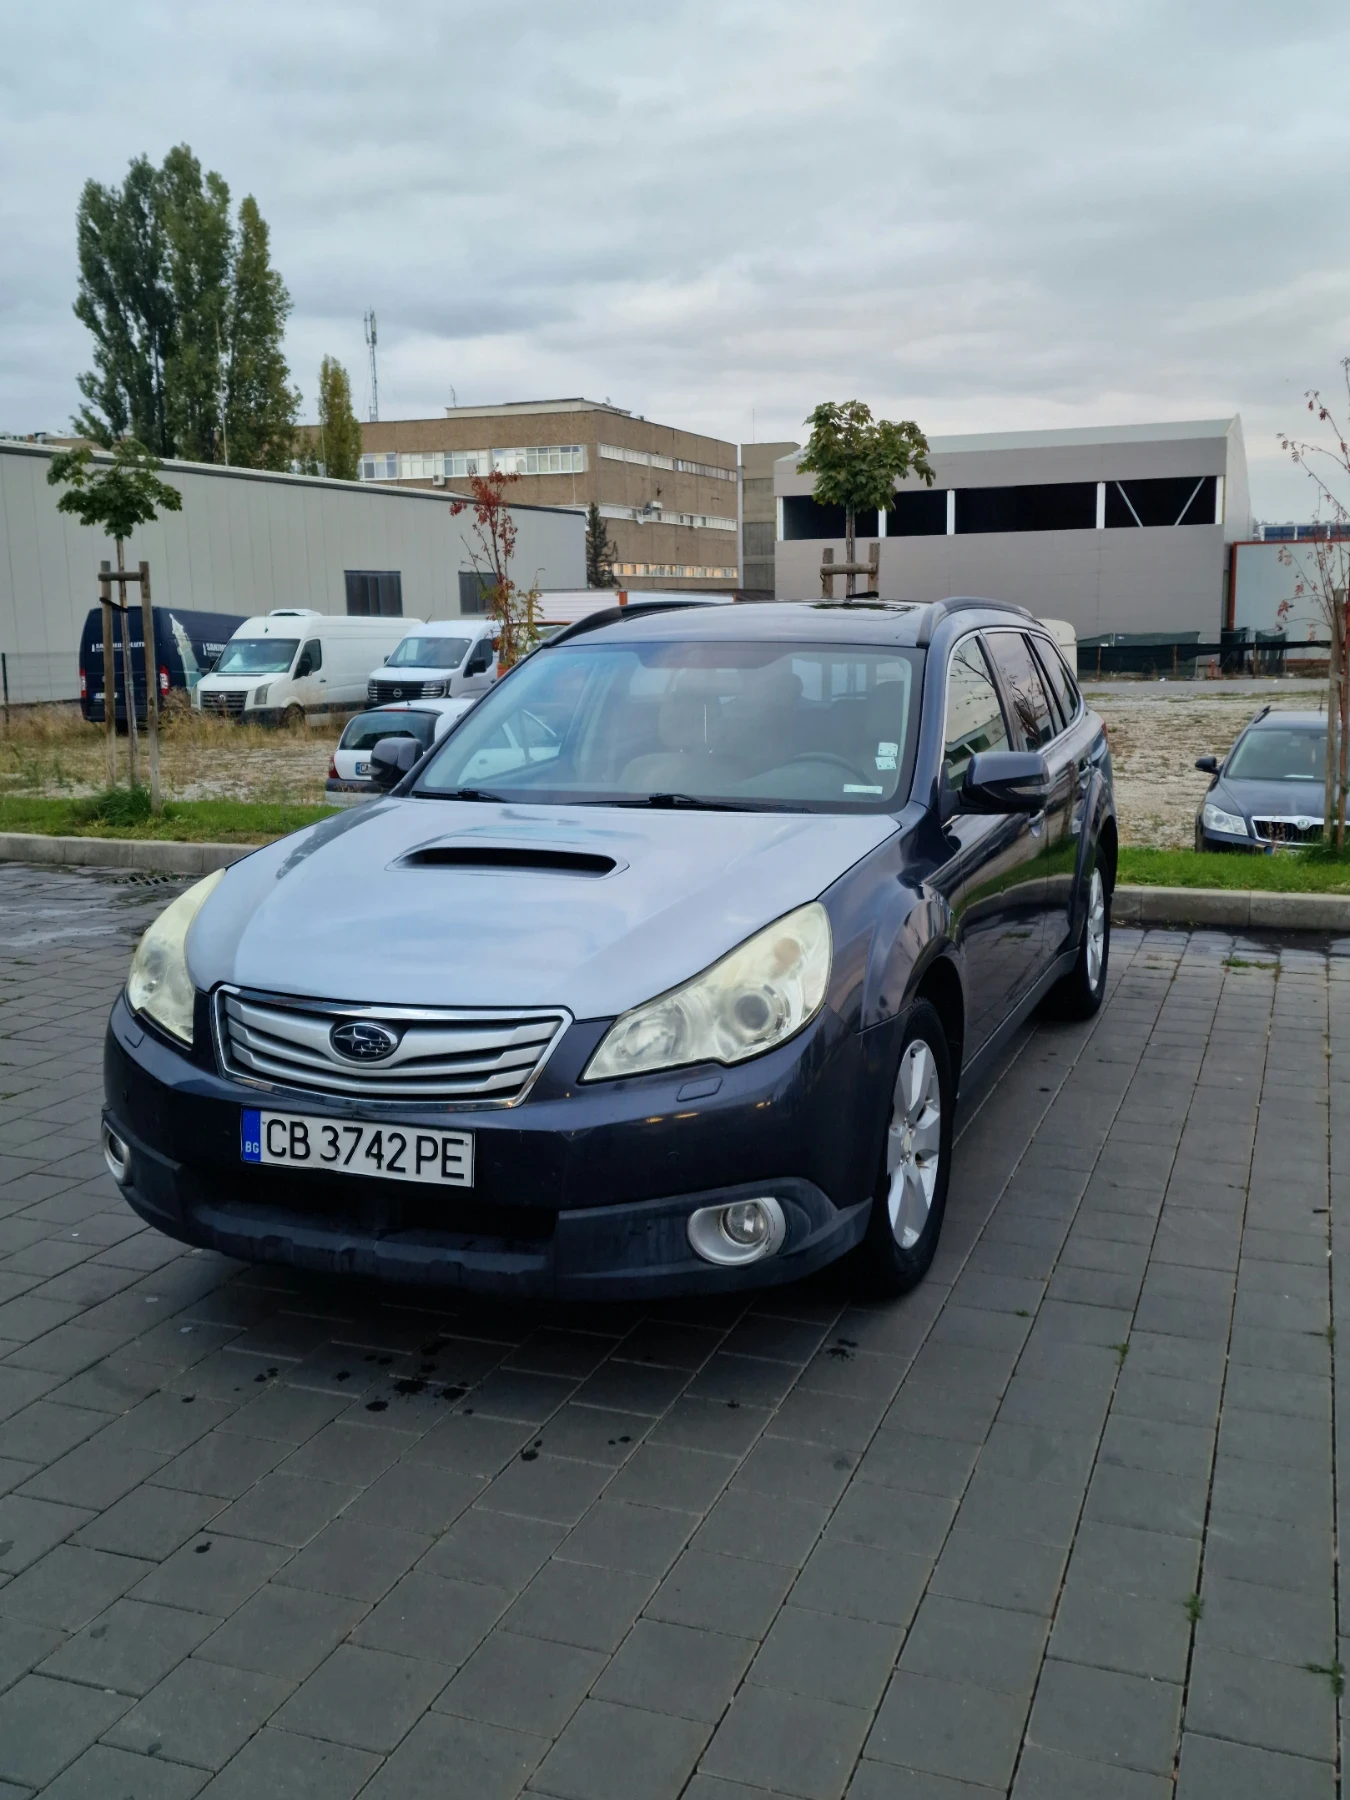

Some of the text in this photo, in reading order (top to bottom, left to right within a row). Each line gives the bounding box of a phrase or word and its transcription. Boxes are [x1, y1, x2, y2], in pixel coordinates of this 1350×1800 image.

[245, 1141, 259, 1153] BG
[266, 1118, 465, 1180] CB 3742 PE
